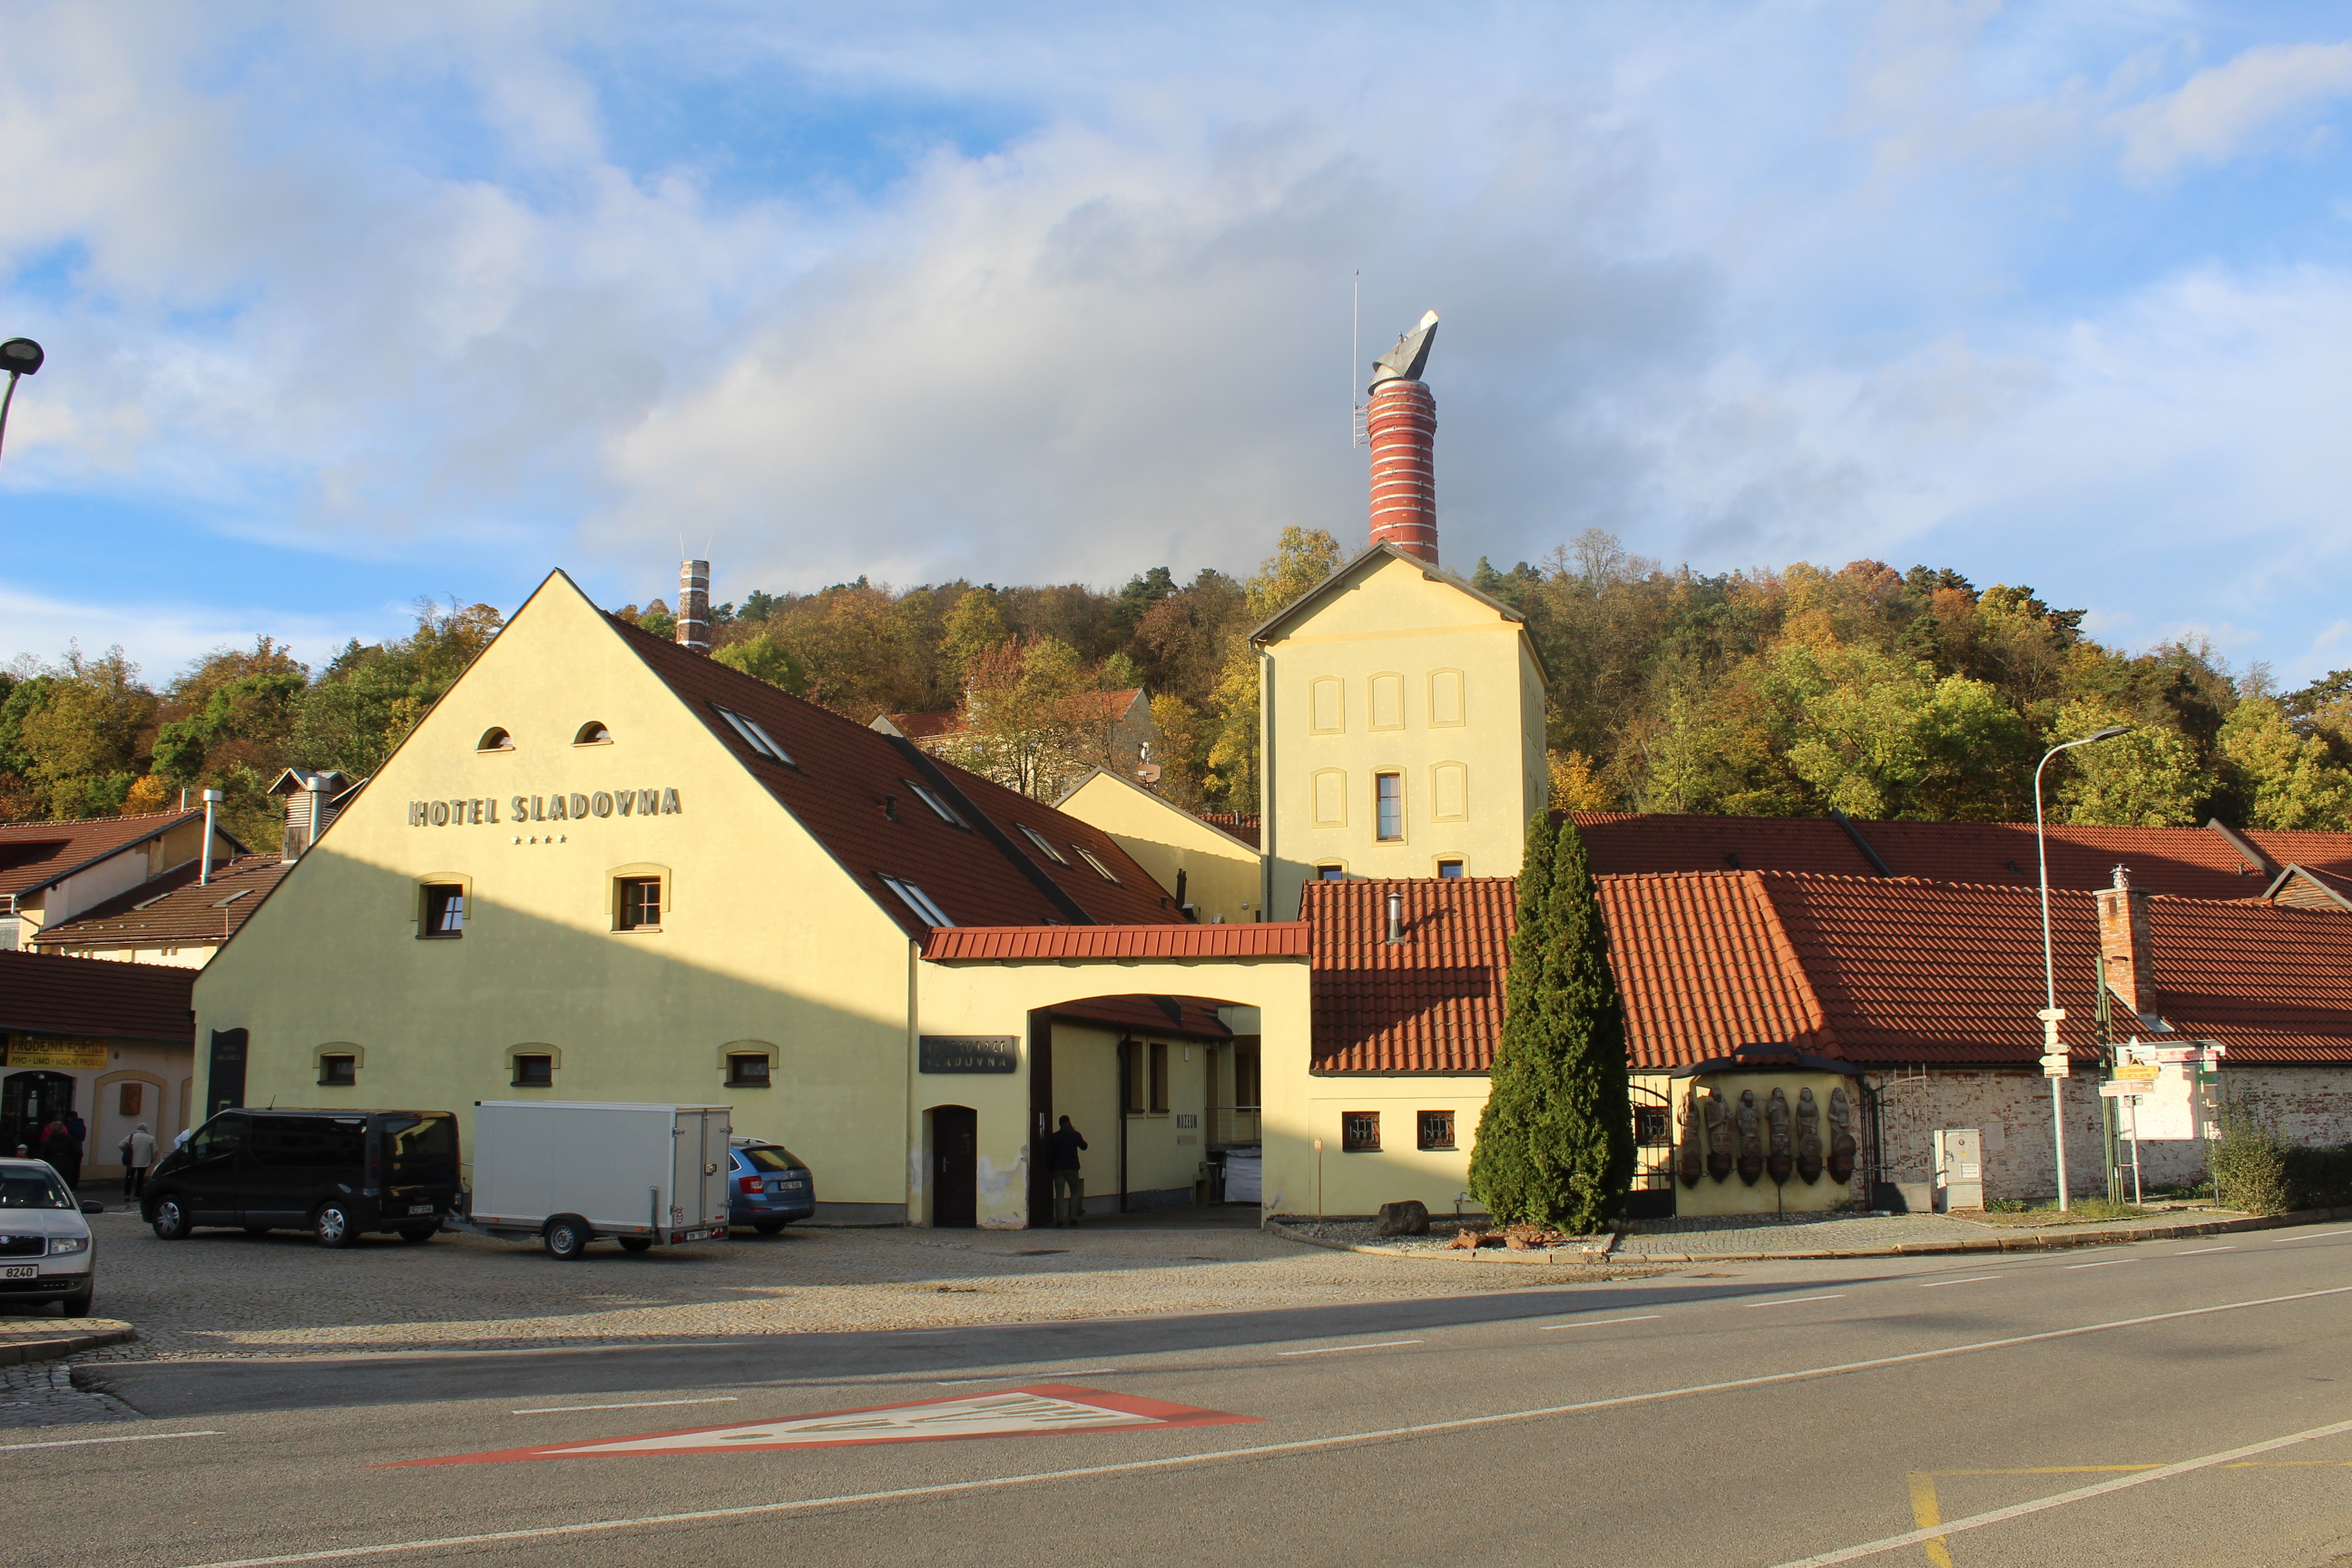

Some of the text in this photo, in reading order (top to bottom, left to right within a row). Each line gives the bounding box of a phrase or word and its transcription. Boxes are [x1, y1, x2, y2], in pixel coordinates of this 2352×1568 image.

[408, 787, 682, 827] HOTEL SLADOVNA
[11, 1040, 64, 1053] PRODEJNA
[68, 1043, 104, 1054] FORTNA
[926, 1040, 1005, 1053] RESTAURACE
[12, 1056, 103, 1066] PIVO LIMO NOČNÍ PRODEJ
[926, 1055, 1006, 1067] SLADOVNA
[1177, 1114, 1197, 1129] MUZEUM
[6, 1267, 33, 1278] 8240
